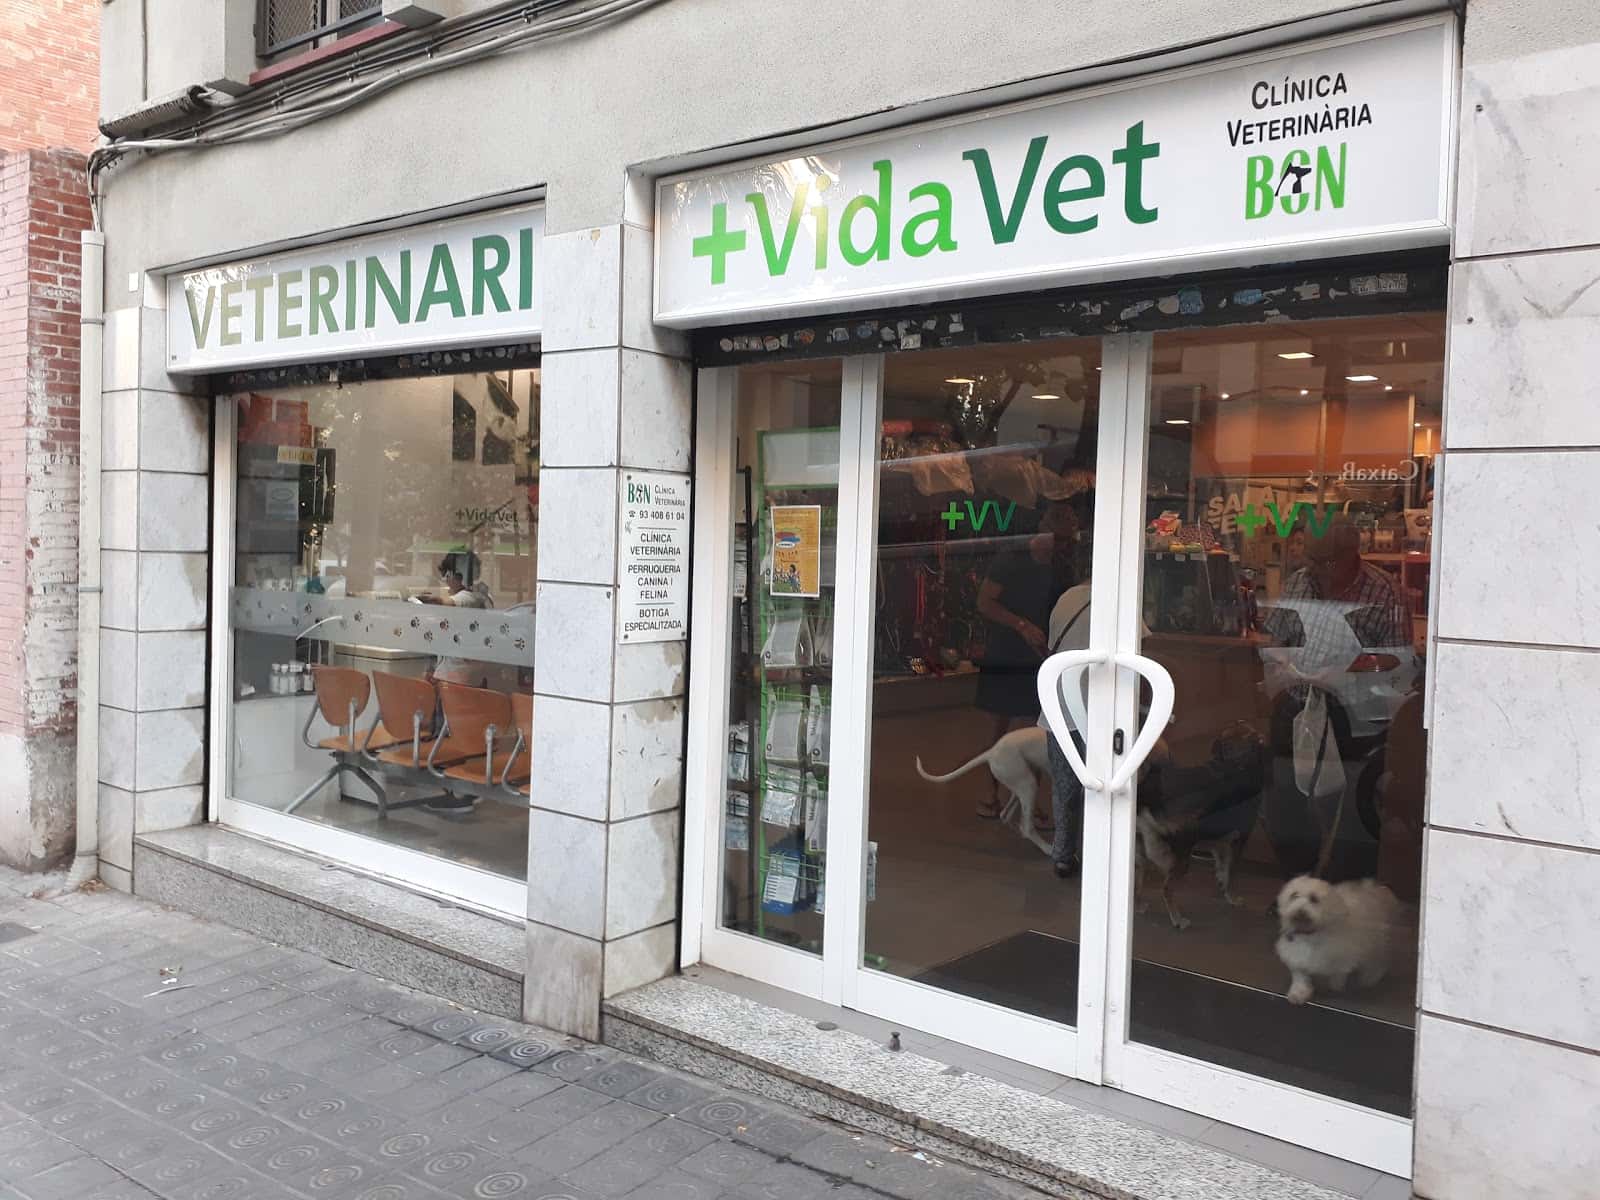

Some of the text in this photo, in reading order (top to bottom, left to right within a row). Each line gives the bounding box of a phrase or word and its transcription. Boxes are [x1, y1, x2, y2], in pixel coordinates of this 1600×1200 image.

[1251, 72, 1347, 110] CLÍNICA
[1227, 103, 1373, 147] VETERINÀRIA
[1244, 142, 1347, 220] BCN
[184, 227, 534, 350] VETERINARI
[639, 510, 685, 520] 93 408 61 04
[640, 531, 672, 543] CLÍNICA
[630, 544, 681, 555] VETERINÀRIA
[627, 564, 681, 574] PERRUQUERIA
[637, 576, 669, 586] CANINA
[639, 589, 668, 600] FELINA
[639, 608, 669, 618] BOTIGA
[624, 619, 682, 632] ESPECIALITZADA
